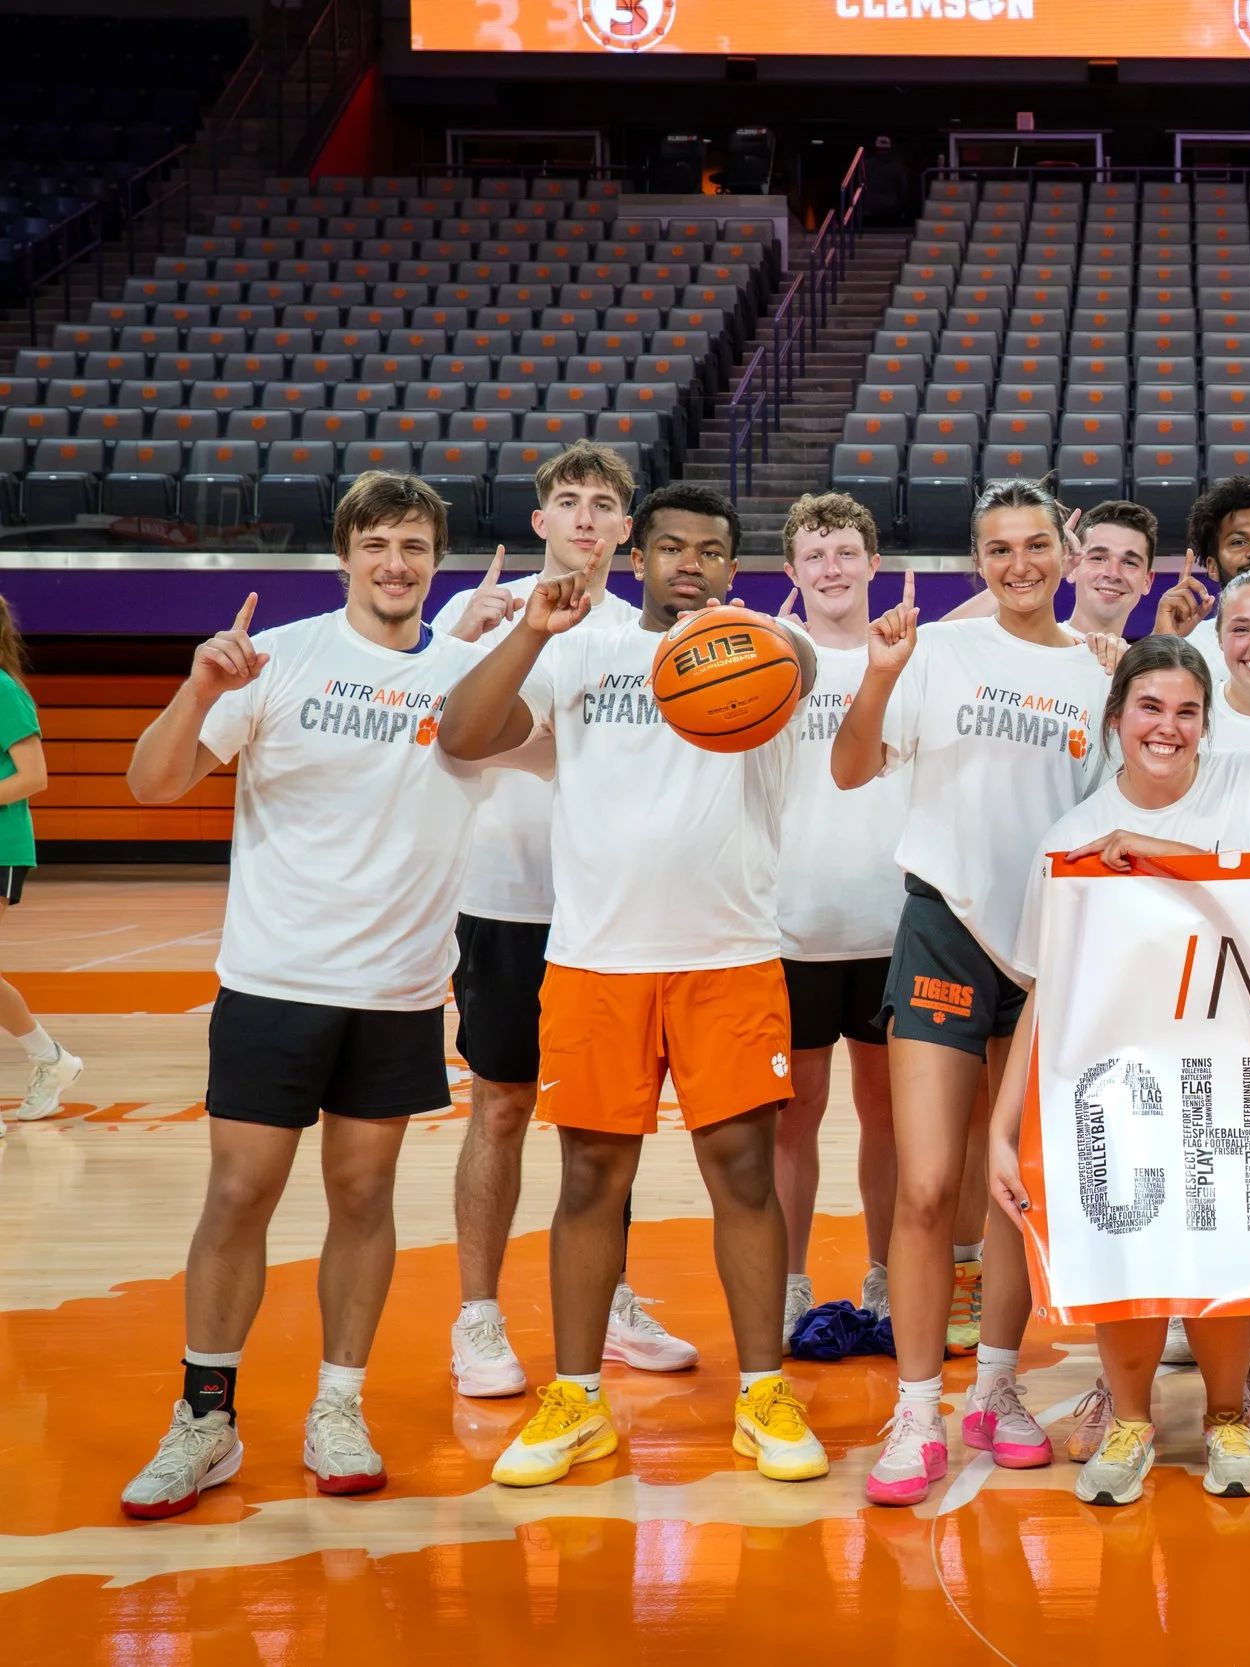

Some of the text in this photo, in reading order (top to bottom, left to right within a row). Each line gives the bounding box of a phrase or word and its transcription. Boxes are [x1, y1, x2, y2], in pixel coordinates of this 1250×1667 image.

[975, 685, 1091, 731] INTRAMURAL
[913, 975, 975, 1007] TIGERS
[1182, 1058, 1212, 1068] TENNIS
[1182, 1081, 1212, 1094] FLAG
[1183, 1109, 1192, 1138] EFFORT
[1192, 1107, 1203, 1126] FUN
[1193, 1128, 1244, 1139] SPIKEBALL
[1183, 1139, 1245, 1148] FLAG FOOTBALL
[1134, 1168, 1165, 1177] TENNIS
[1184, 1150, 1196, 1197] RESPECT
[1196, 1149, 1214, 1185] PLAY
[1081, 1192, 1108, 1204] EFFORT
